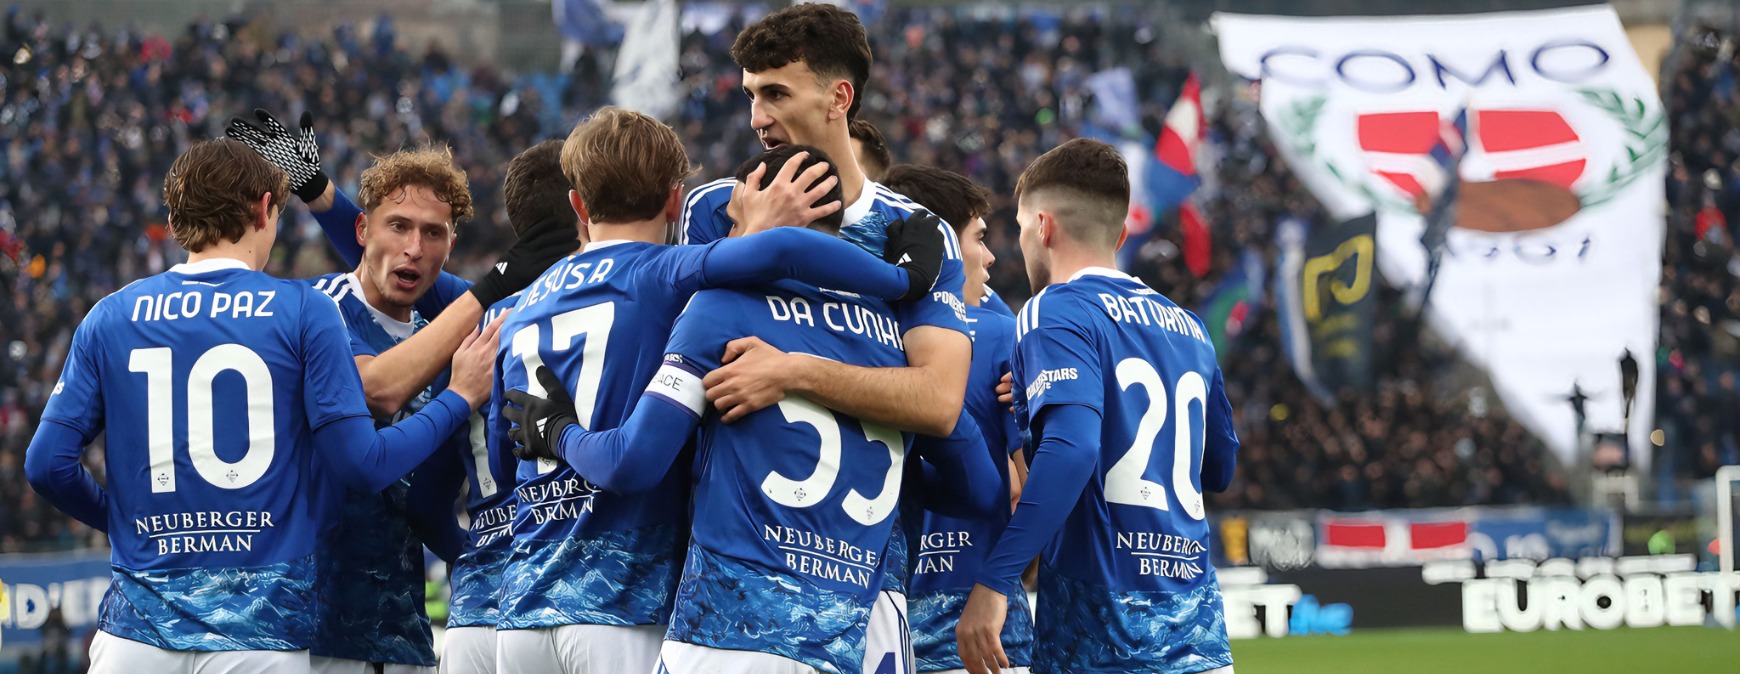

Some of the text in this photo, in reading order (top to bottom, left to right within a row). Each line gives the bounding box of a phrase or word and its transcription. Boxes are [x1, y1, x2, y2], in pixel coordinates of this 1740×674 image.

[1261, 39, 1609, 92] COMO
[131, 290, 276, 322] NICO PAZ
[518, 258, 614, 312] JESUS R
[766, 295, 814, 327] DA
[1098, 293, 1206, 344] BATURINA
[512, 301, 615, 475] 17
[653, 374, 683, 391] ACE
[128, 343, 275, 493] 10
[1103, 357, 1206, 521] 20
[136, 511, 275, 535] NEUBERGER
[157, 534, 253, 556] BERMAN
[764, 524, 880, 568] NEUBERGE
[785, 552, 870, 589] BERMAN
[1463, 571, 1740, 633] EUROBET
